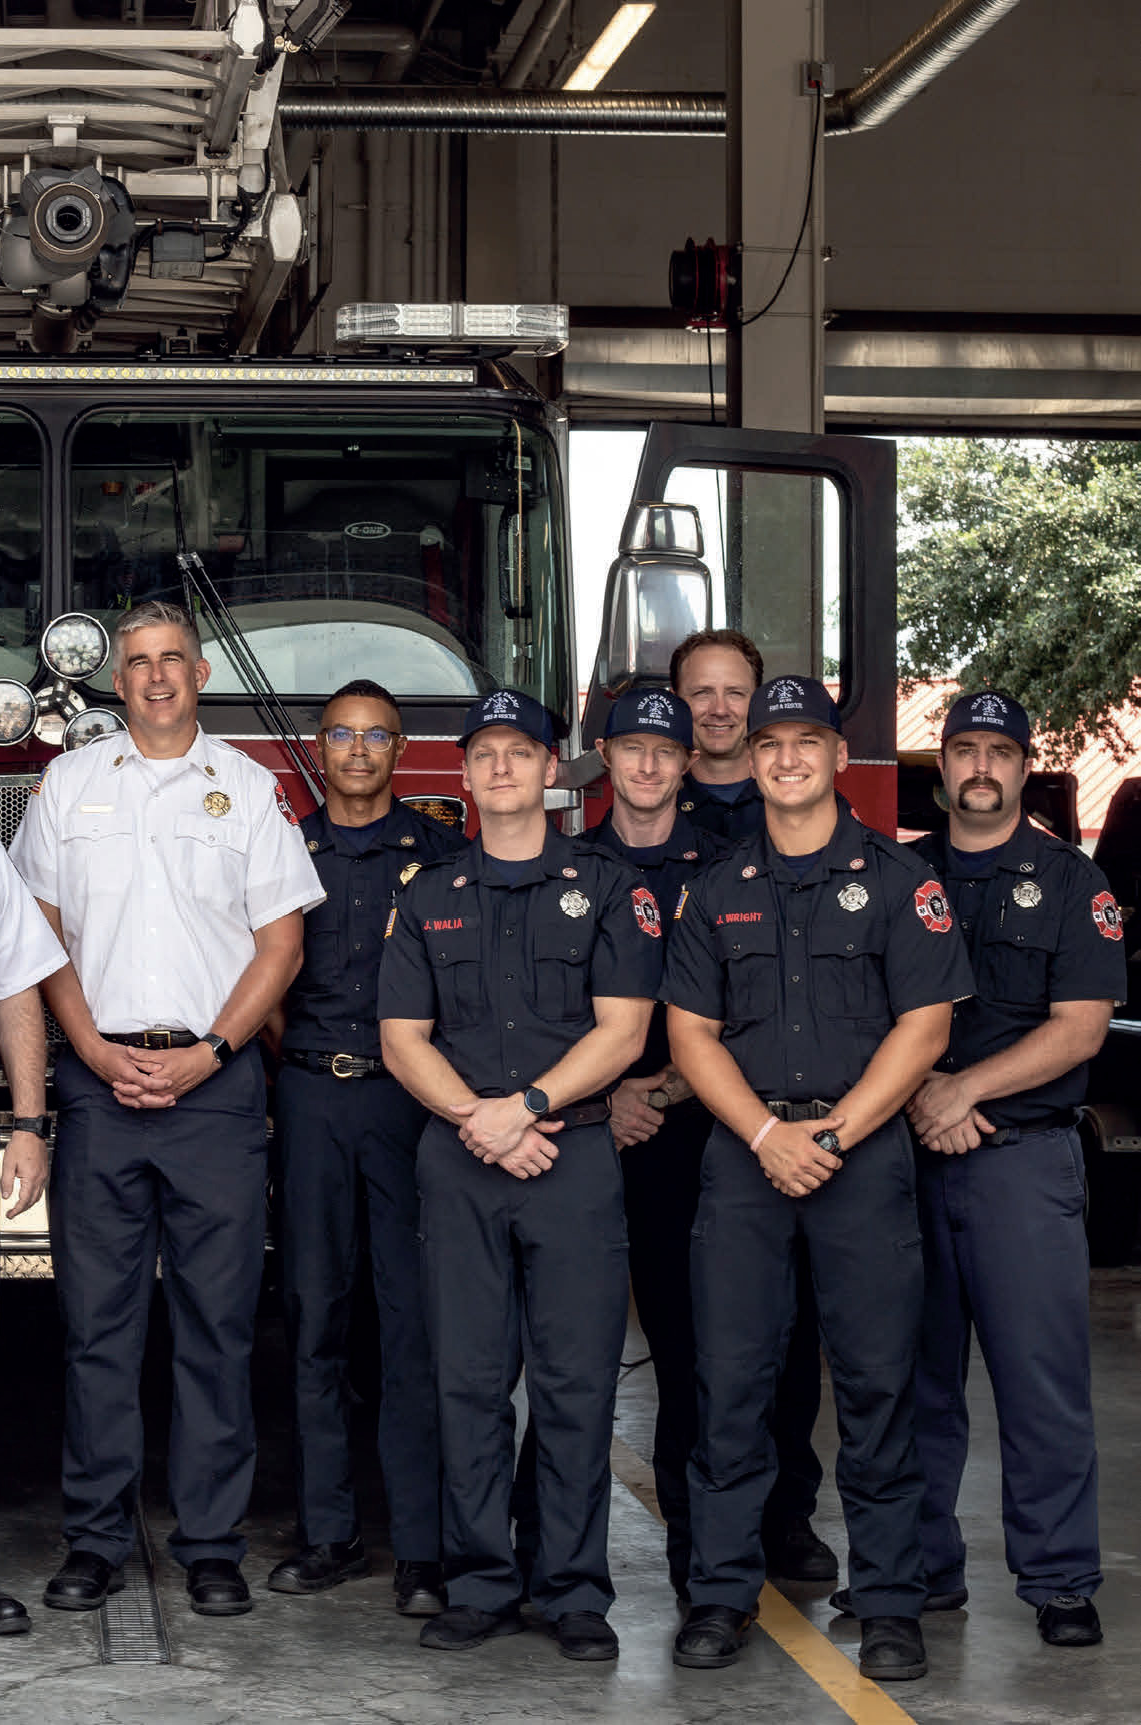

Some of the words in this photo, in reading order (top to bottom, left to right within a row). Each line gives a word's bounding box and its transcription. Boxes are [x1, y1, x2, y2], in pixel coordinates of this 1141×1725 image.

[423, 920, 431, 930] J.
[433, 917, 463, 930] WALIA
[725, 912, 763, 923] WRIGHT
